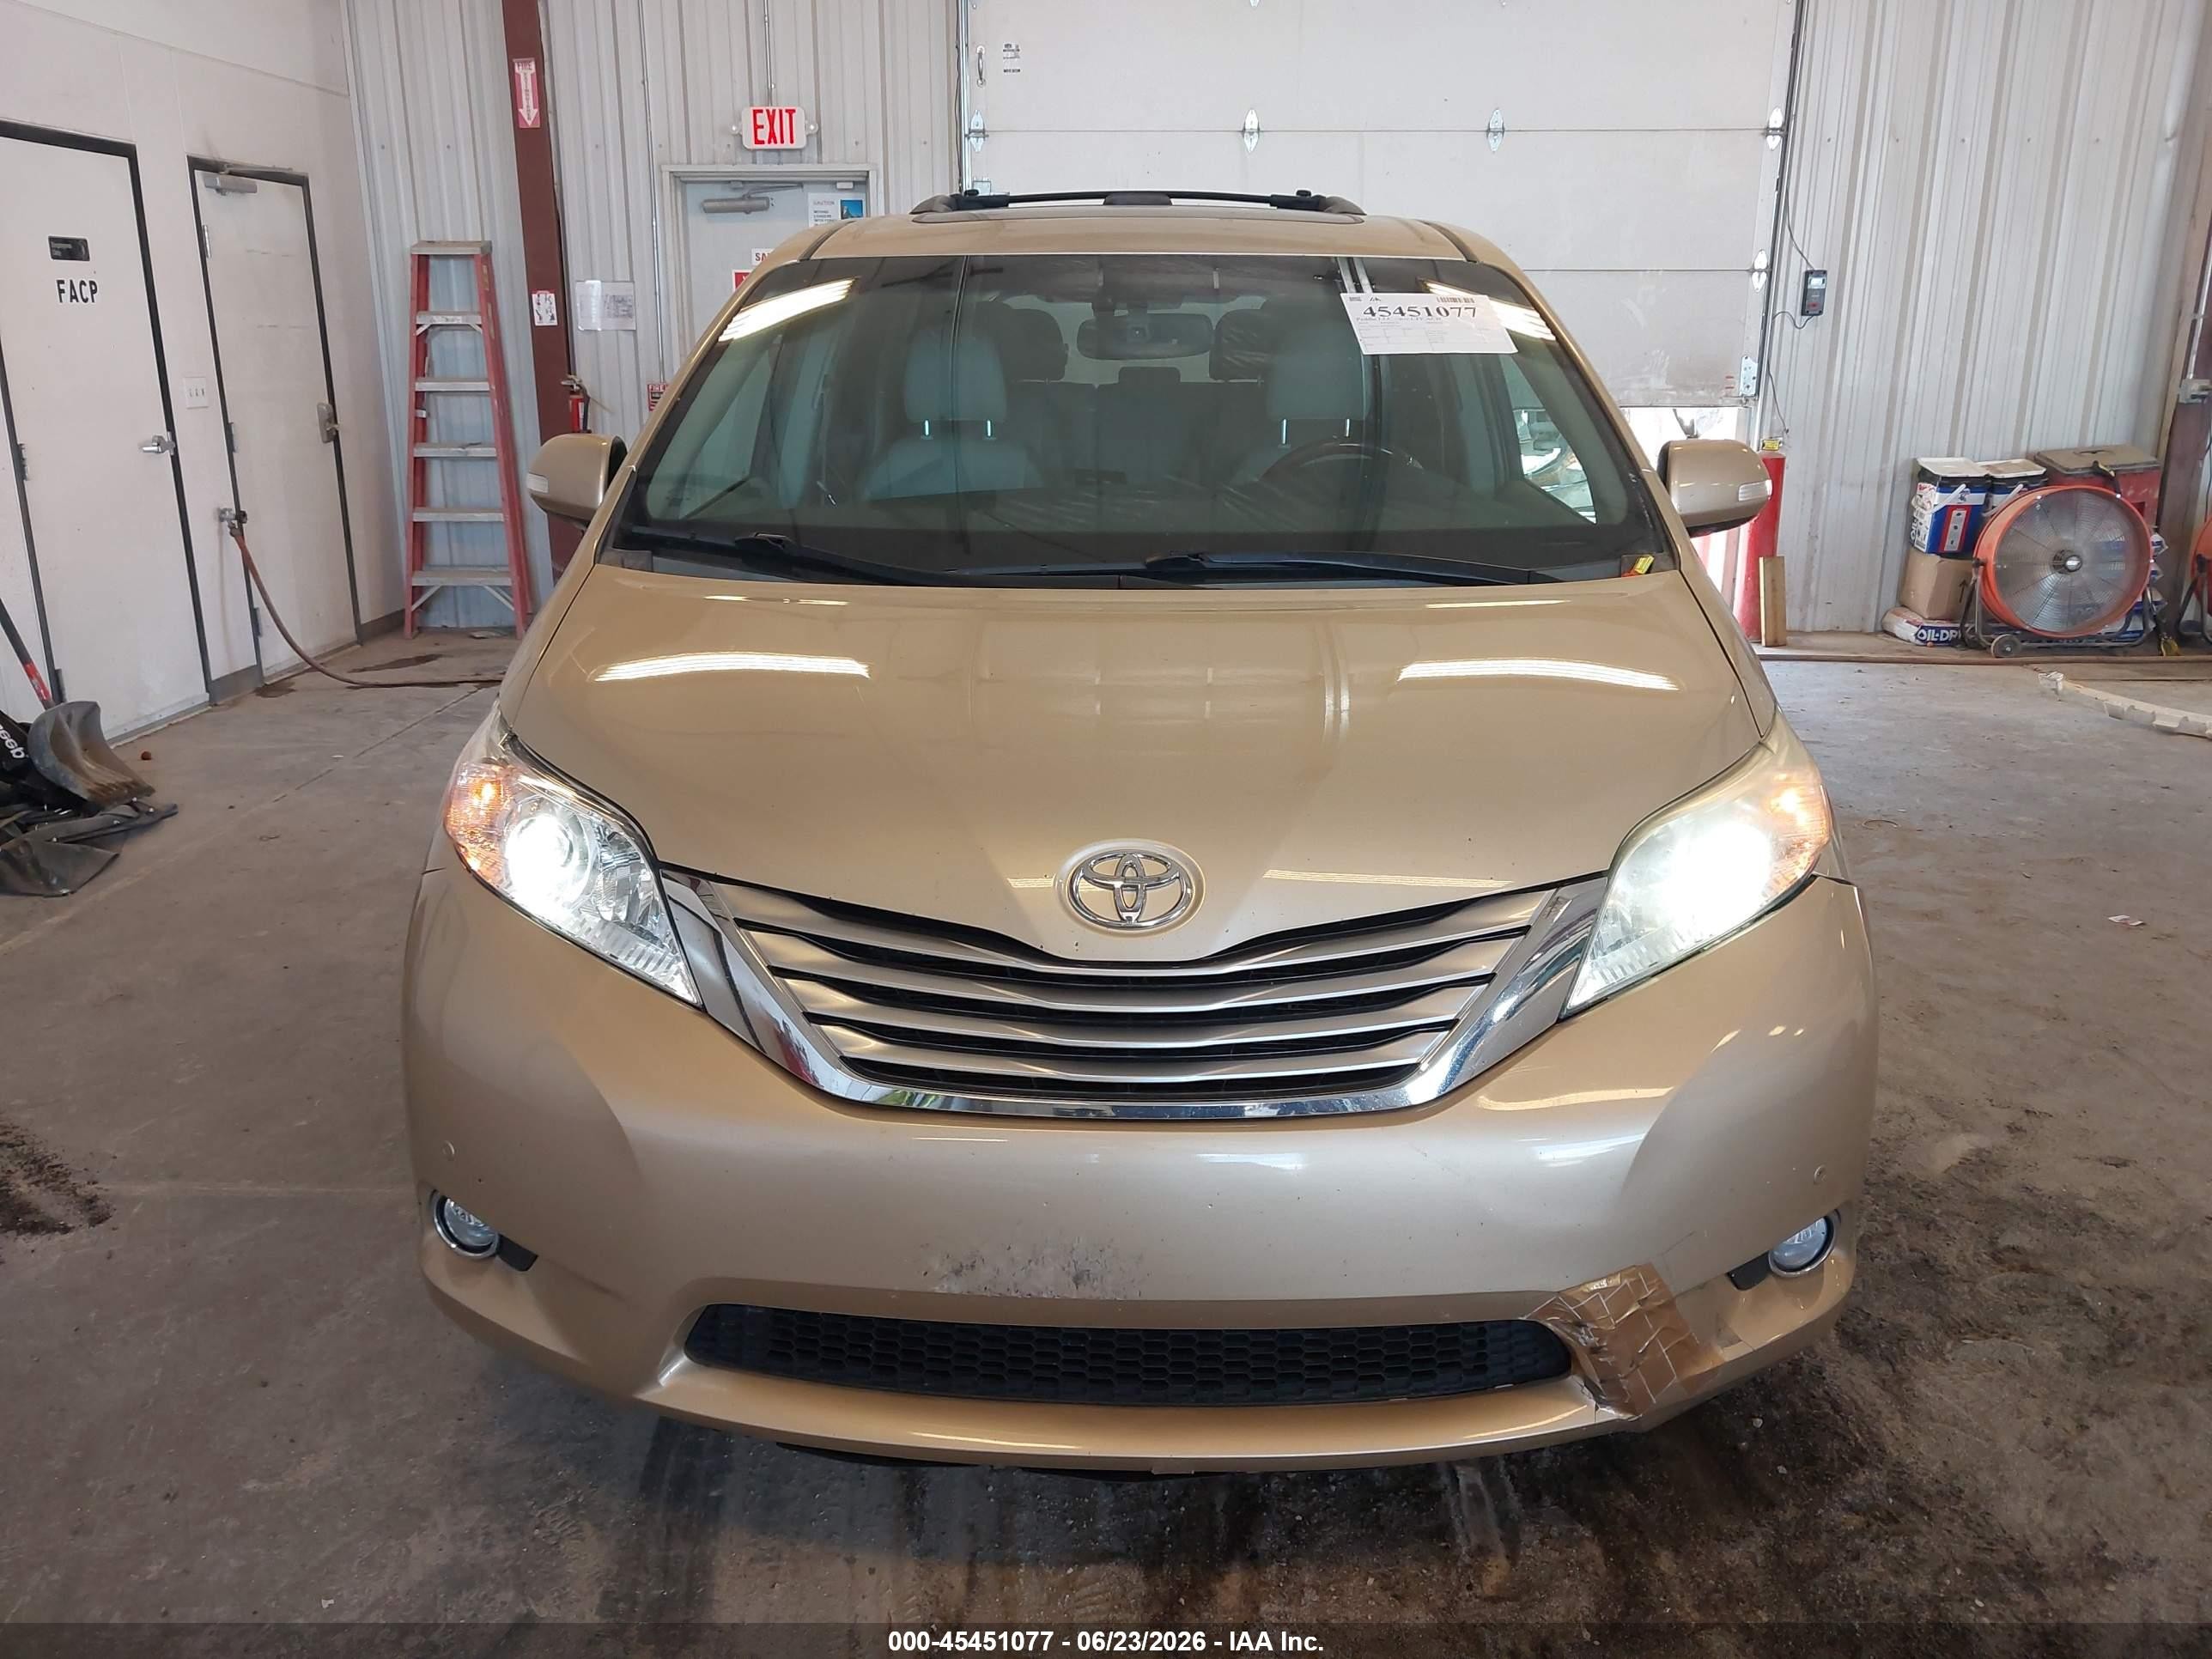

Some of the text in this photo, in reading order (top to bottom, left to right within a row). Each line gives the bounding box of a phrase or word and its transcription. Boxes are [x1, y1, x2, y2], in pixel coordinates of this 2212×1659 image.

[752, 109, 796, 145] EXIT
[56, 279, 98, 303] FACP
[1363, 306, 1477, 318] 45451077
